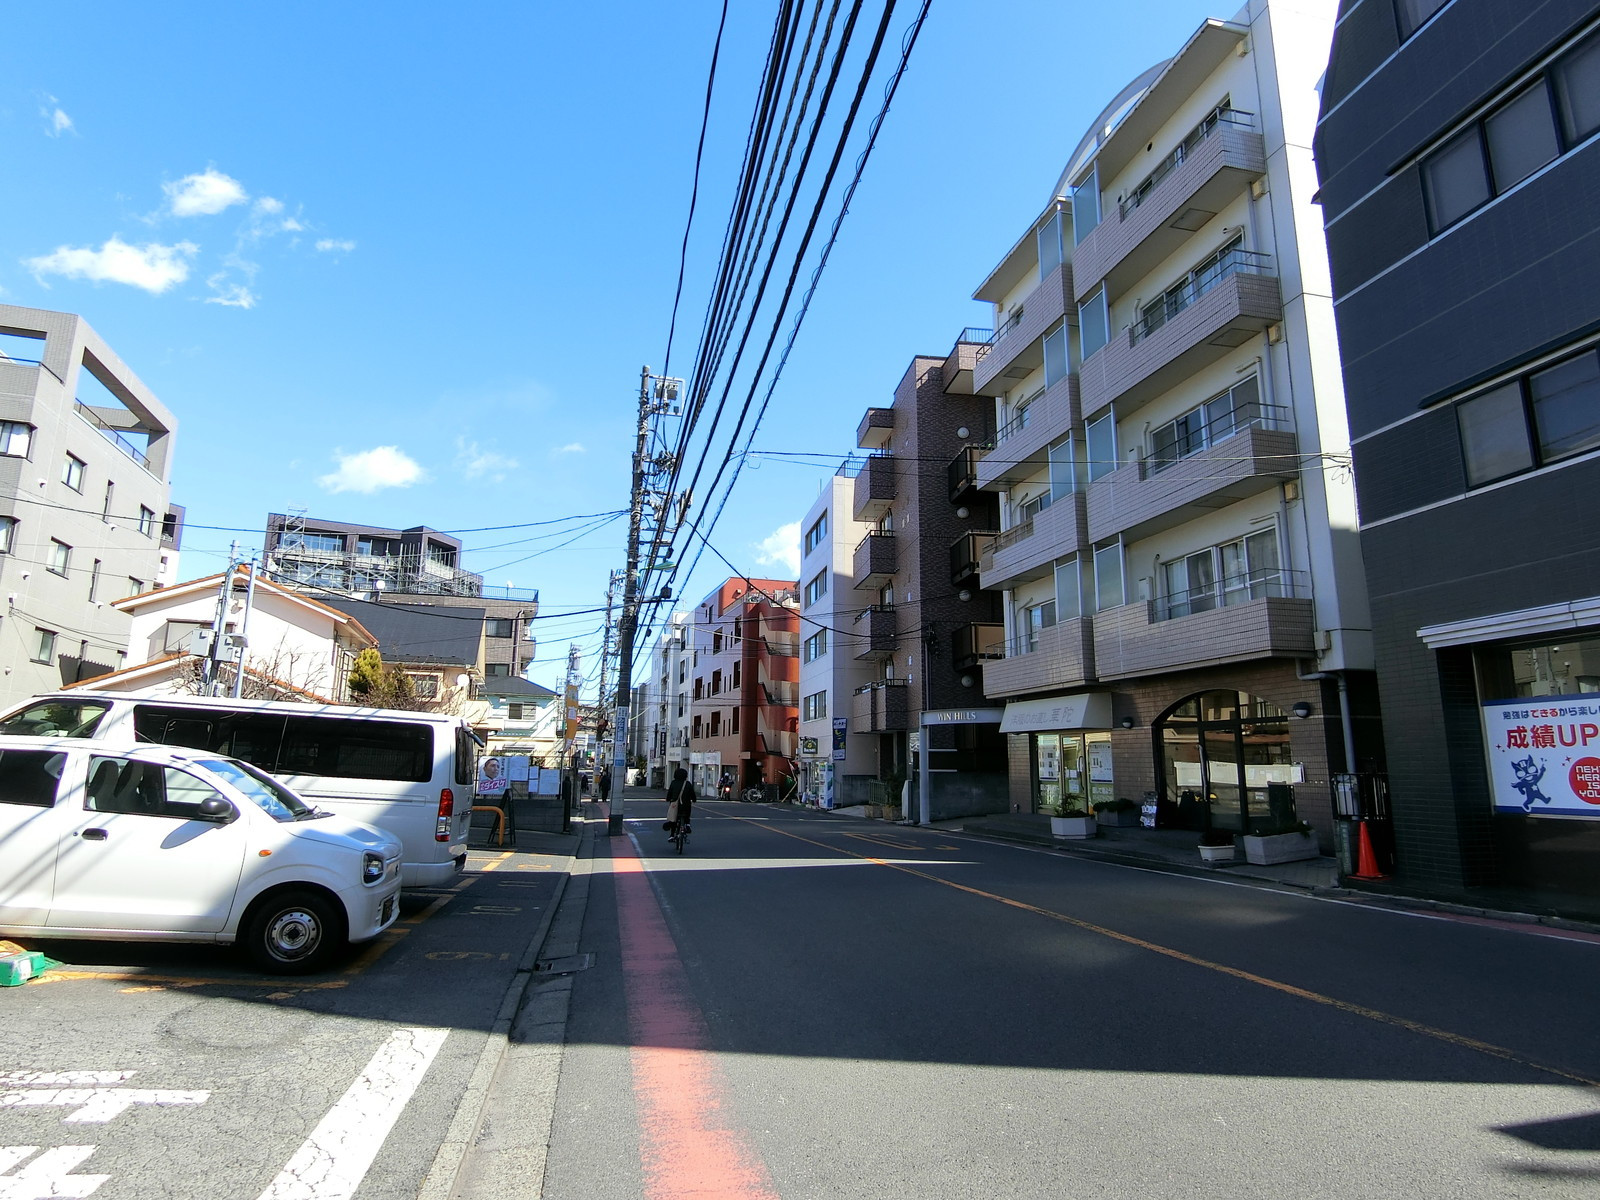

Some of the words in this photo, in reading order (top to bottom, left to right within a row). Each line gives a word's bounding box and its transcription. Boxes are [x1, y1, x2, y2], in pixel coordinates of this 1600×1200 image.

[937, 712, 952, 721] WIN
[954, 711, 977, 721] HILLS
[1575, 765, 1600, 773] NEX
